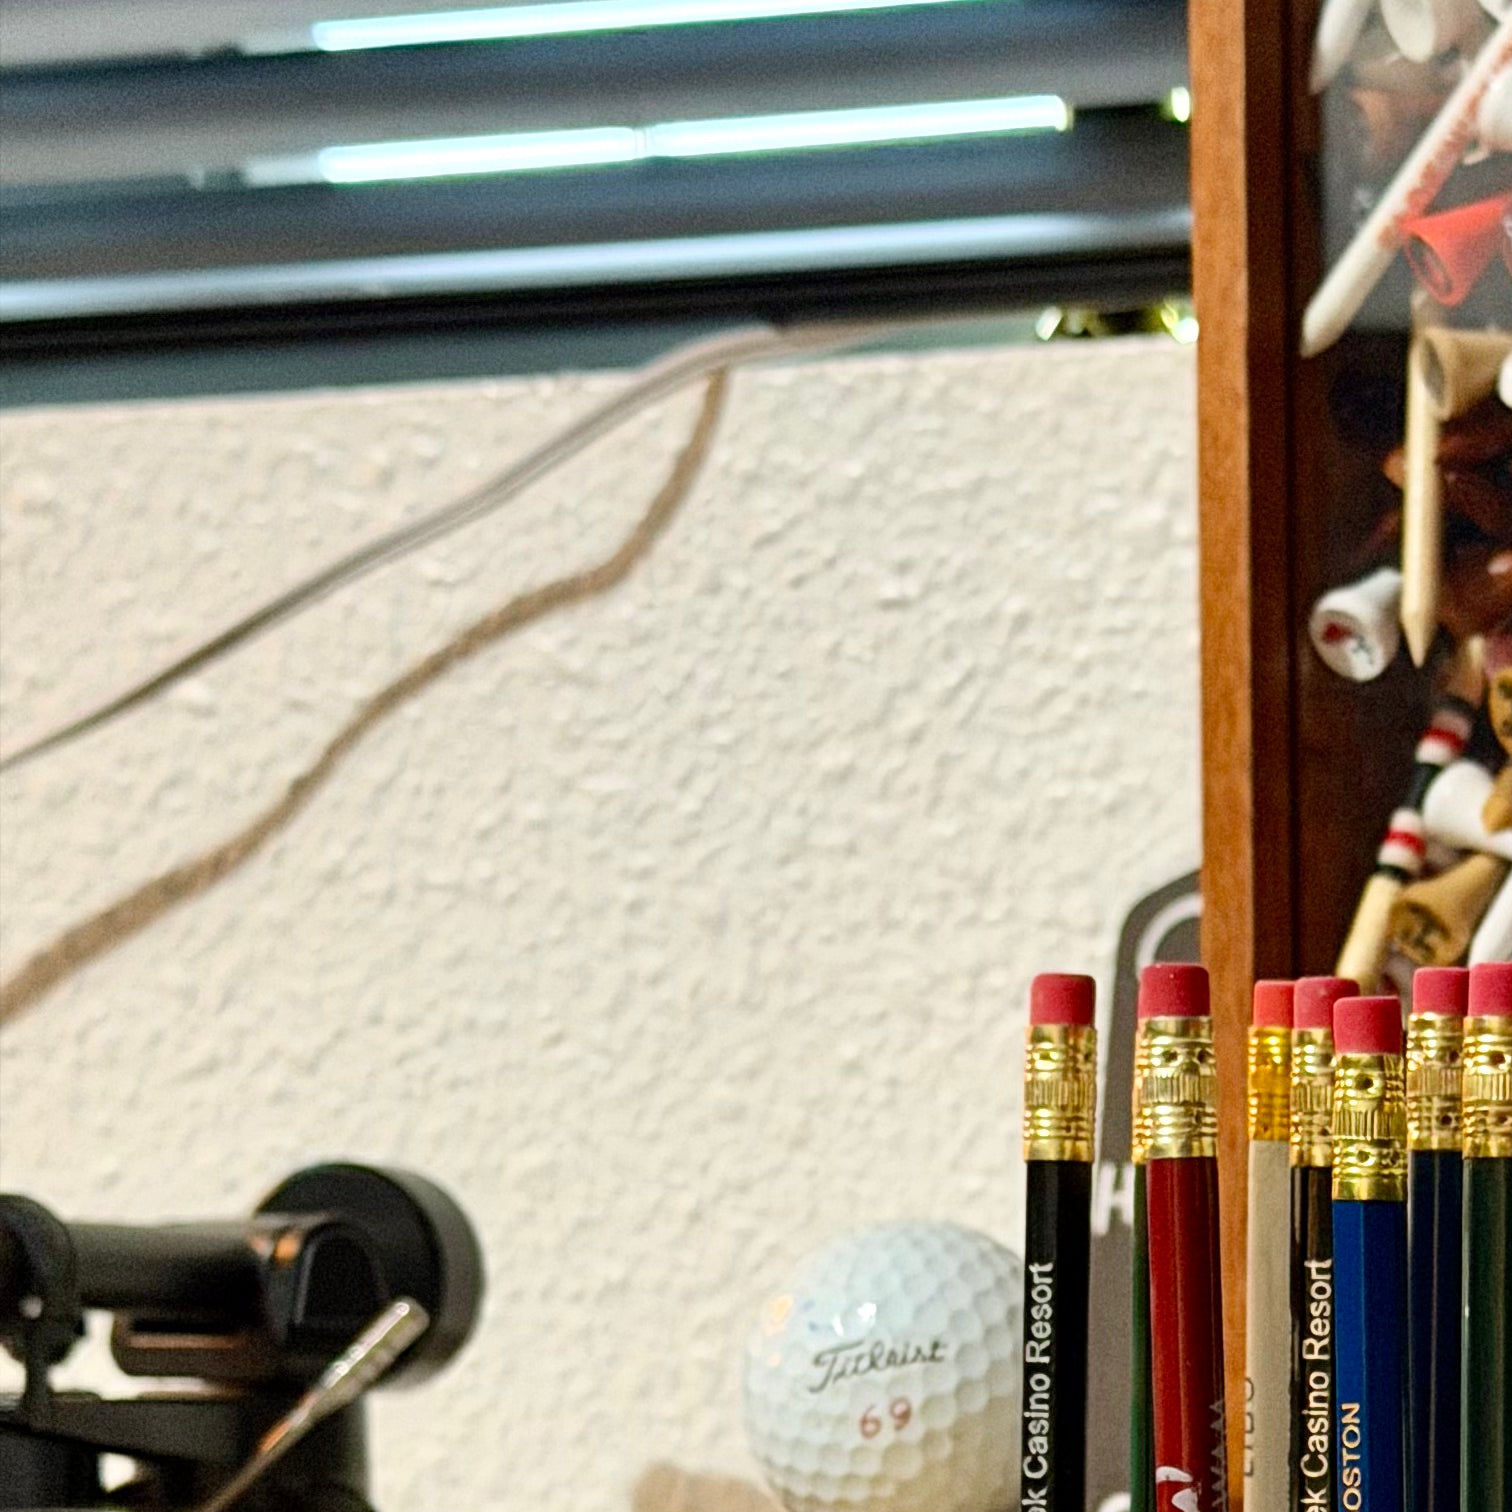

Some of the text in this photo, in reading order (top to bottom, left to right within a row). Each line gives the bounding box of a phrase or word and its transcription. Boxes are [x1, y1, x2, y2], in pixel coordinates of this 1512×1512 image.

[1025, 1262, 1054, 1364] Resort
[1302, 1258, 1333, 1360] Resort
[1023, 1373, 1051, 1480] Casino
[1300, 1371, 1330, 1478] Casino
